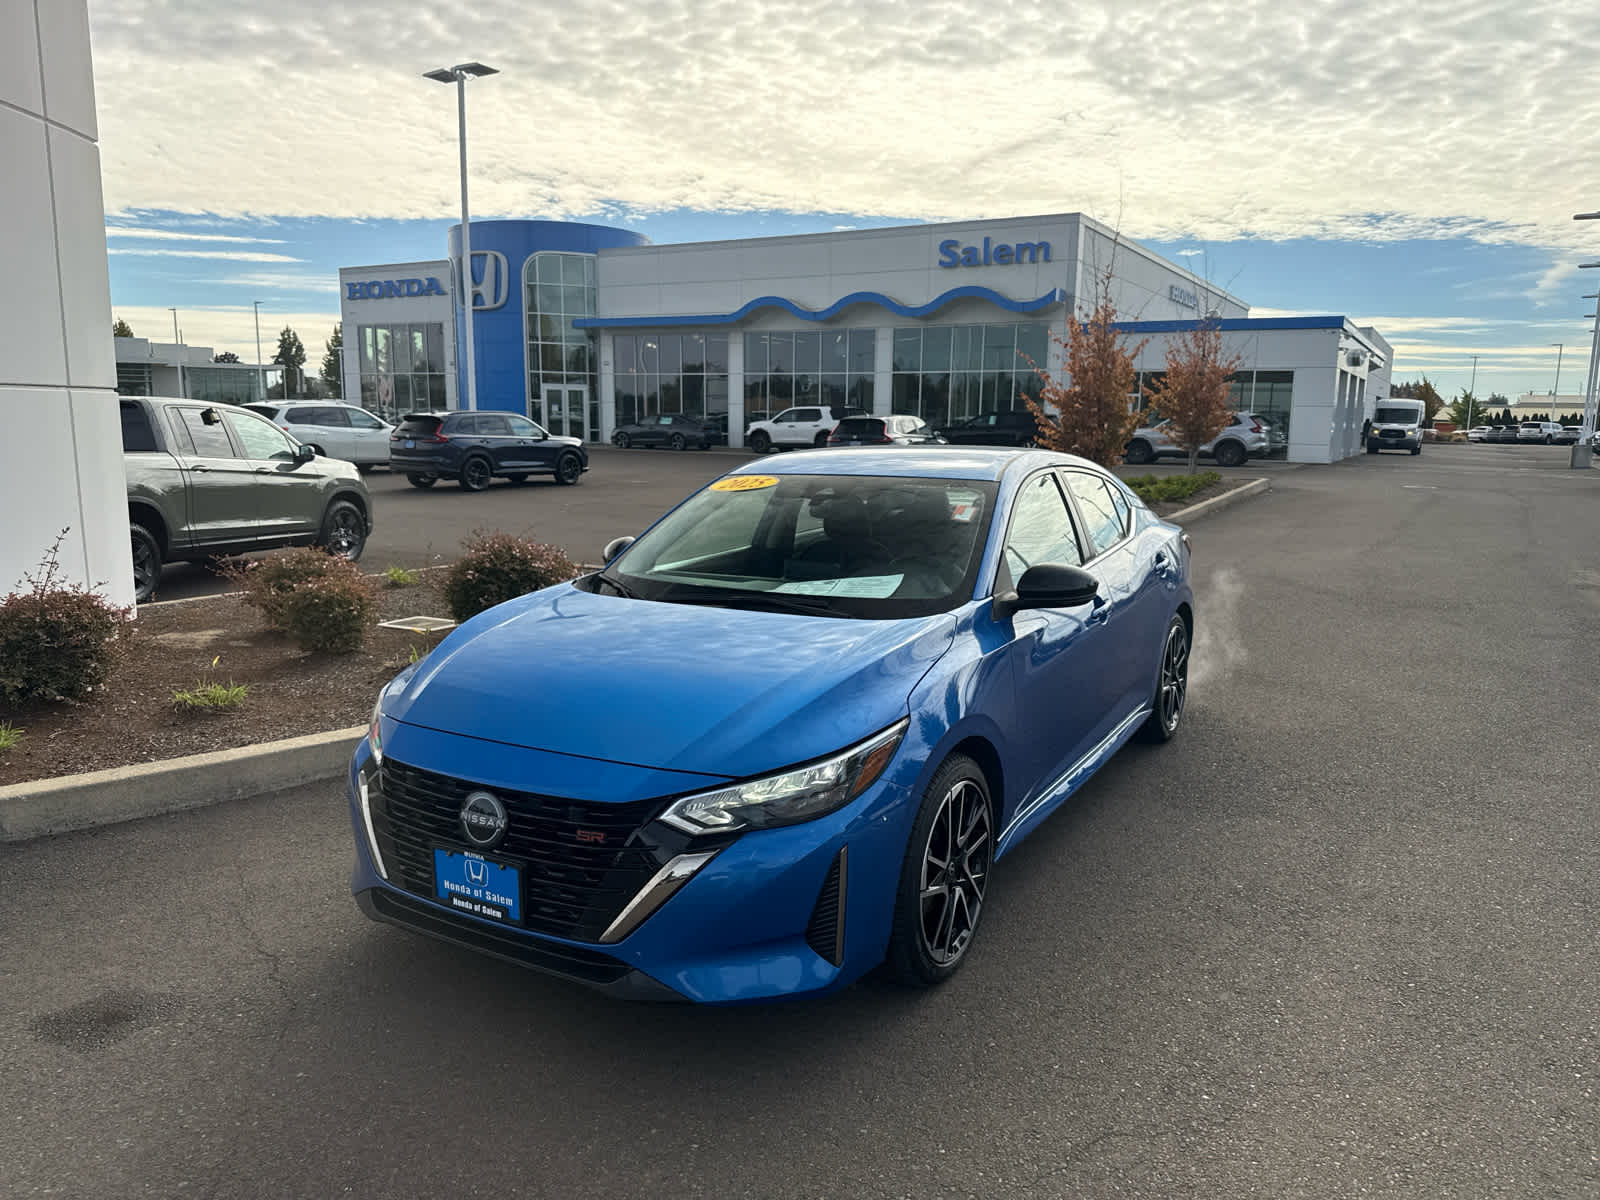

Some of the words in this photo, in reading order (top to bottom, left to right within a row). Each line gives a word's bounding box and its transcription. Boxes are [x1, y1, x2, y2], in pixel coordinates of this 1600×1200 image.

[939, 236, 1051, 268] Salem
[346, 277, 447, 300] HONDA
[460, 810, 505, 828] NISSAN
[576, 829, 604, 843] SR
[444, 880, 471, 895] Honda
[474, 889, 482, 898] of
[486, 890, 513, 906] Salem
[453, 897, 473, 910] Honda
[474, 904, 481, 913] of
[482, 905, 502, 919] Salem
